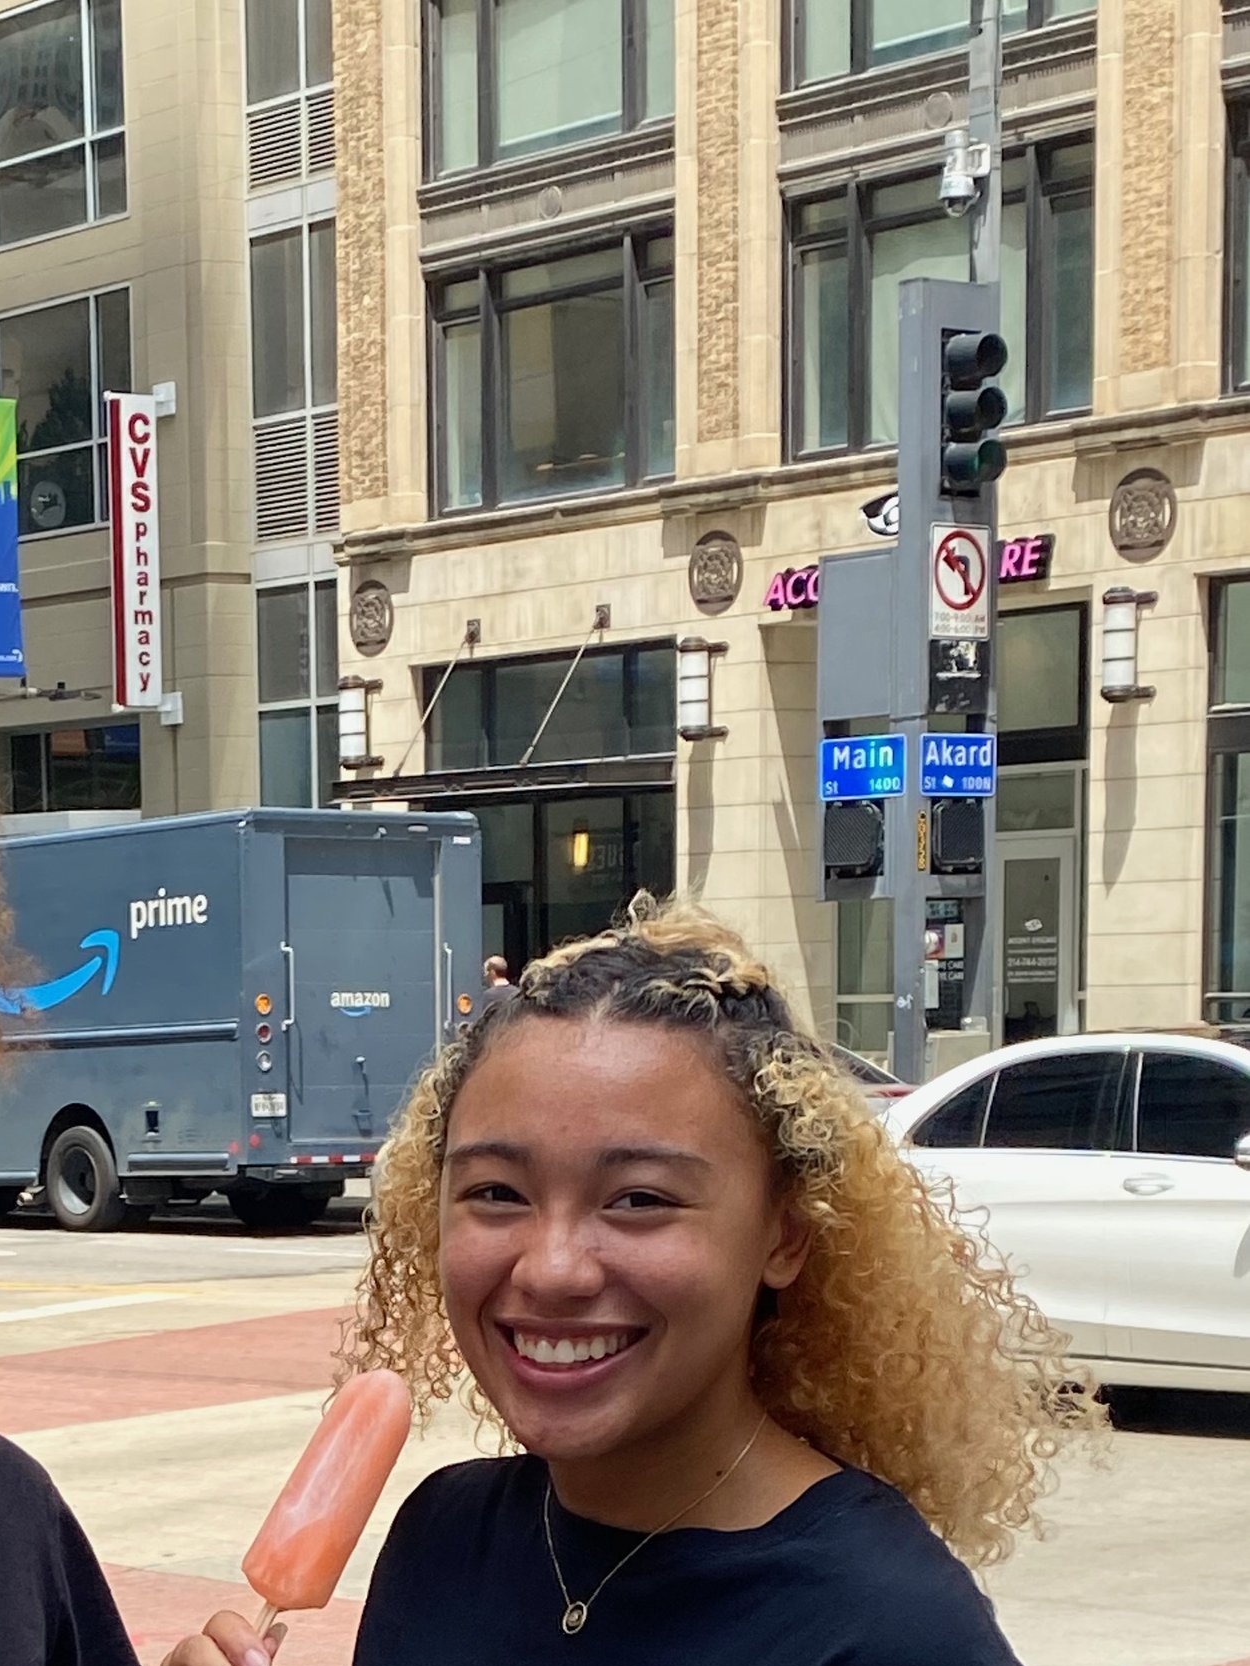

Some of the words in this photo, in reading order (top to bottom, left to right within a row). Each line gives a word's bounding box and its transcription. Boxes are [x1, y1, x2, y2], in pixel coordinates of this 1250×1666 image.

[128, 412, 151, 513] CVS
[133, 521, 153, 692] pharmacy
[833, 741, 893, 770] Main
[925, 739, 992, 767] Akard
[825, 781, 838, 794] St
[924, 776, 936, 789] St
[961, 776, 991, 791] 100N
[130, 887, 208, 940] prime
[331, 991, 390, 1008] amazon
